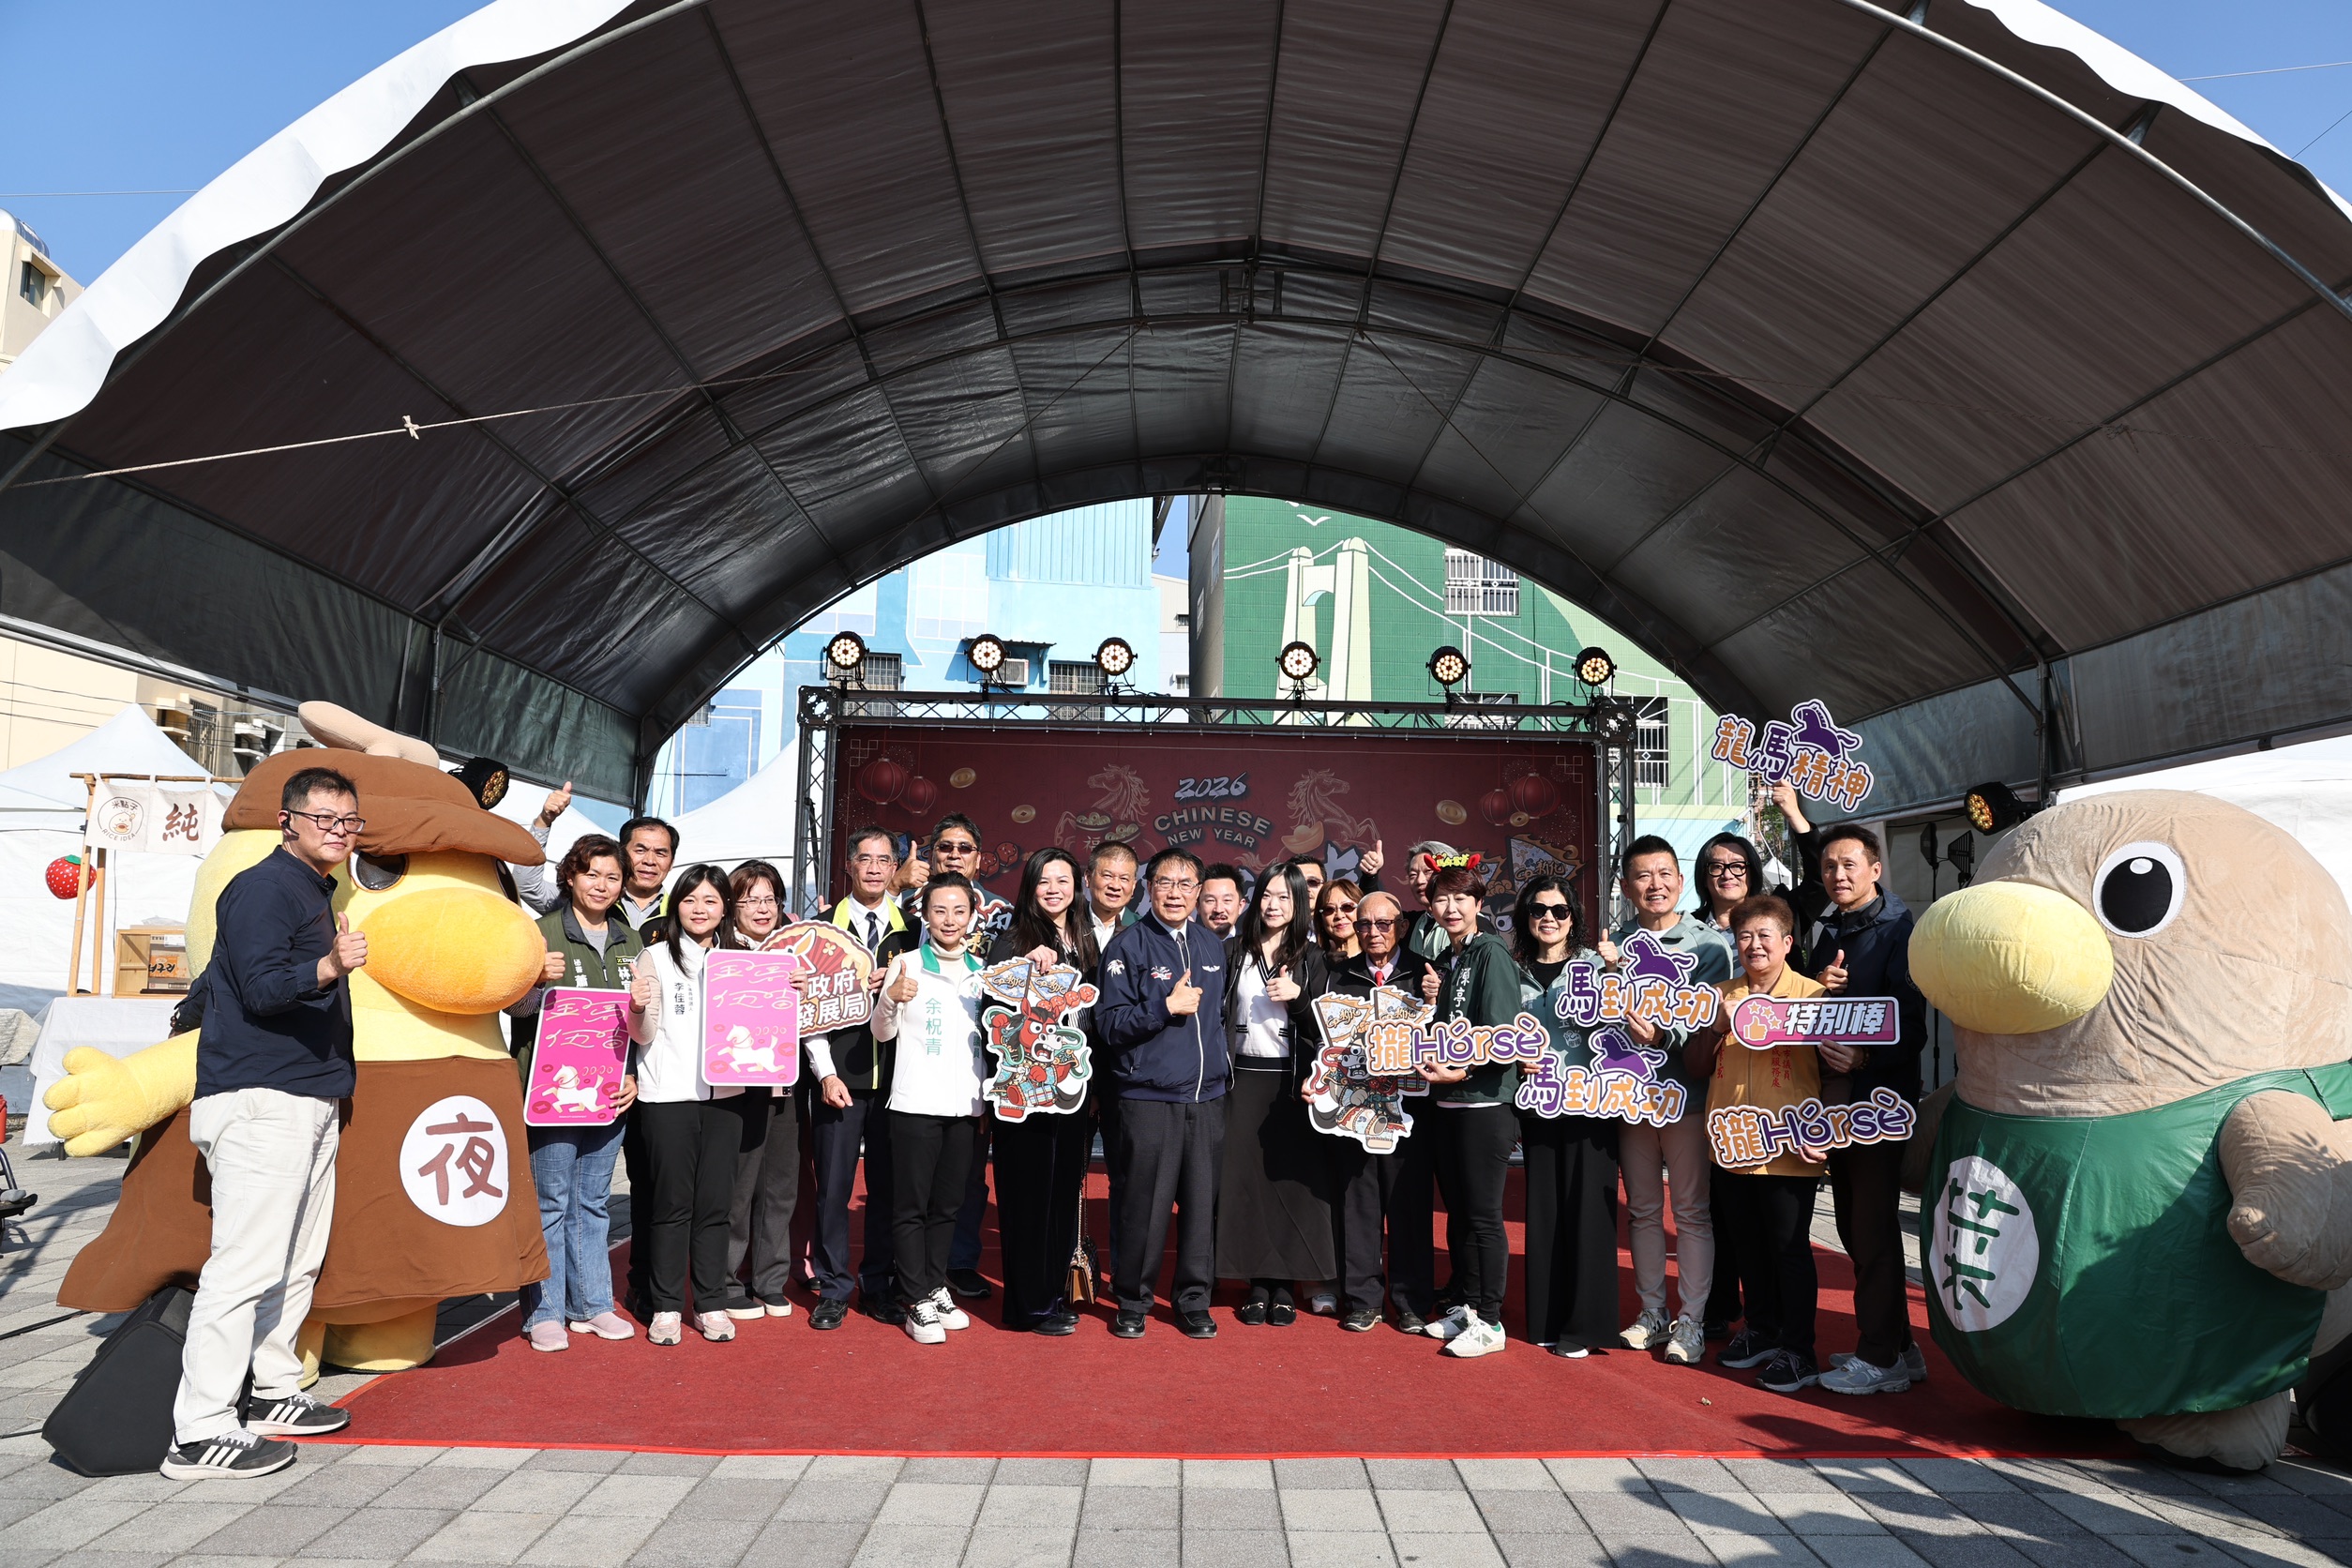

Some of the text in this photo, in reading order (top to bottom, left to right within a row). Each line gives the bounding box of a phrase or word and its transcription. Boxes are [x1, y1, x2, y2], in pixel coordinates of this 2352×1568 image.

[1714, 719, 1868, 807] 龍馬精神
[112, 799, 139, 811] 米點子
[1174, 772, 1247, 802] 2026
[101, 828, 136, 842] RICE IDEA
[162, 803, 200, 842] 純
[1153, 807, 1271, 836] CHINESE
[1167, 828, 1256, 848] NEW YEAR
[807, 969, 856, 1000] 政府
[1558, 966, 1714, 1028] 馬到成功
[800, 991, 866, 1030] 發展局
[925, 998, 942, 1056] 余柷青
[1784, 1003, 1888, 1036] 特別棒
[1782, 1045, 1792, 1081] 市議員
[1520, 1059, 1681, 1121] 馬到成功
[417, 1111, 504, 1206] 夜
